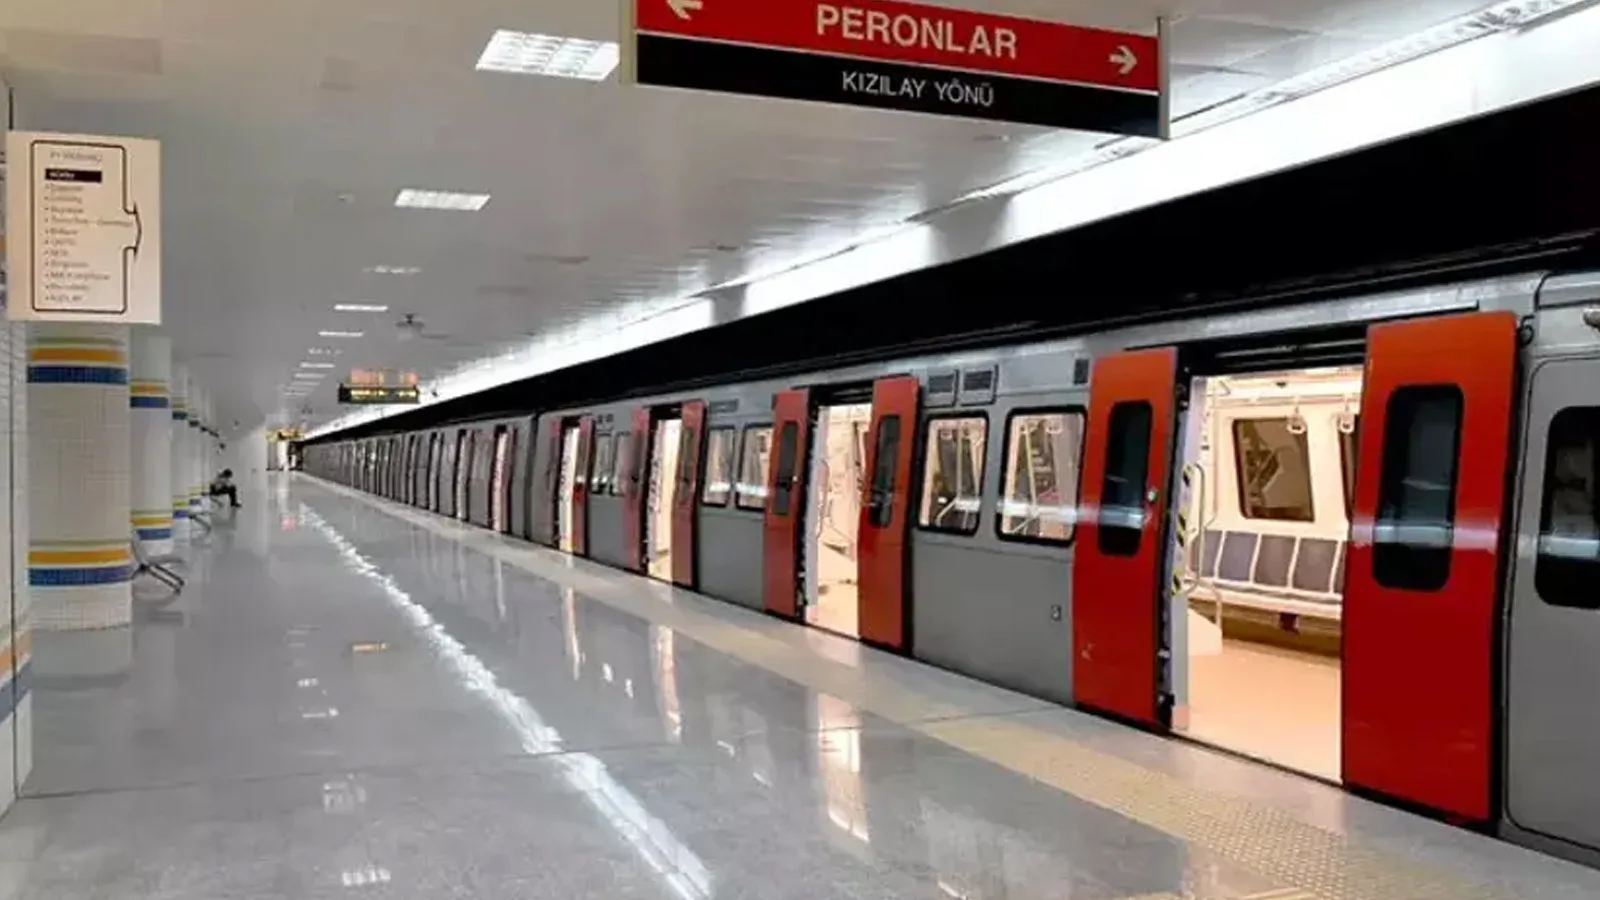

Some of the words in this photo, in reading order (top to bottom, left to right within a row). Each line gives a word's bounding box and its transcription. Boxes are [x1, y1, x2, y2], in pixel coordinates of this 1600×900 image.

[816, 4, 1017, 59] PERONLAR
[842, 70, 928, 98] KIZILAY
[935, 79, 994, 107] YÖNÜ
